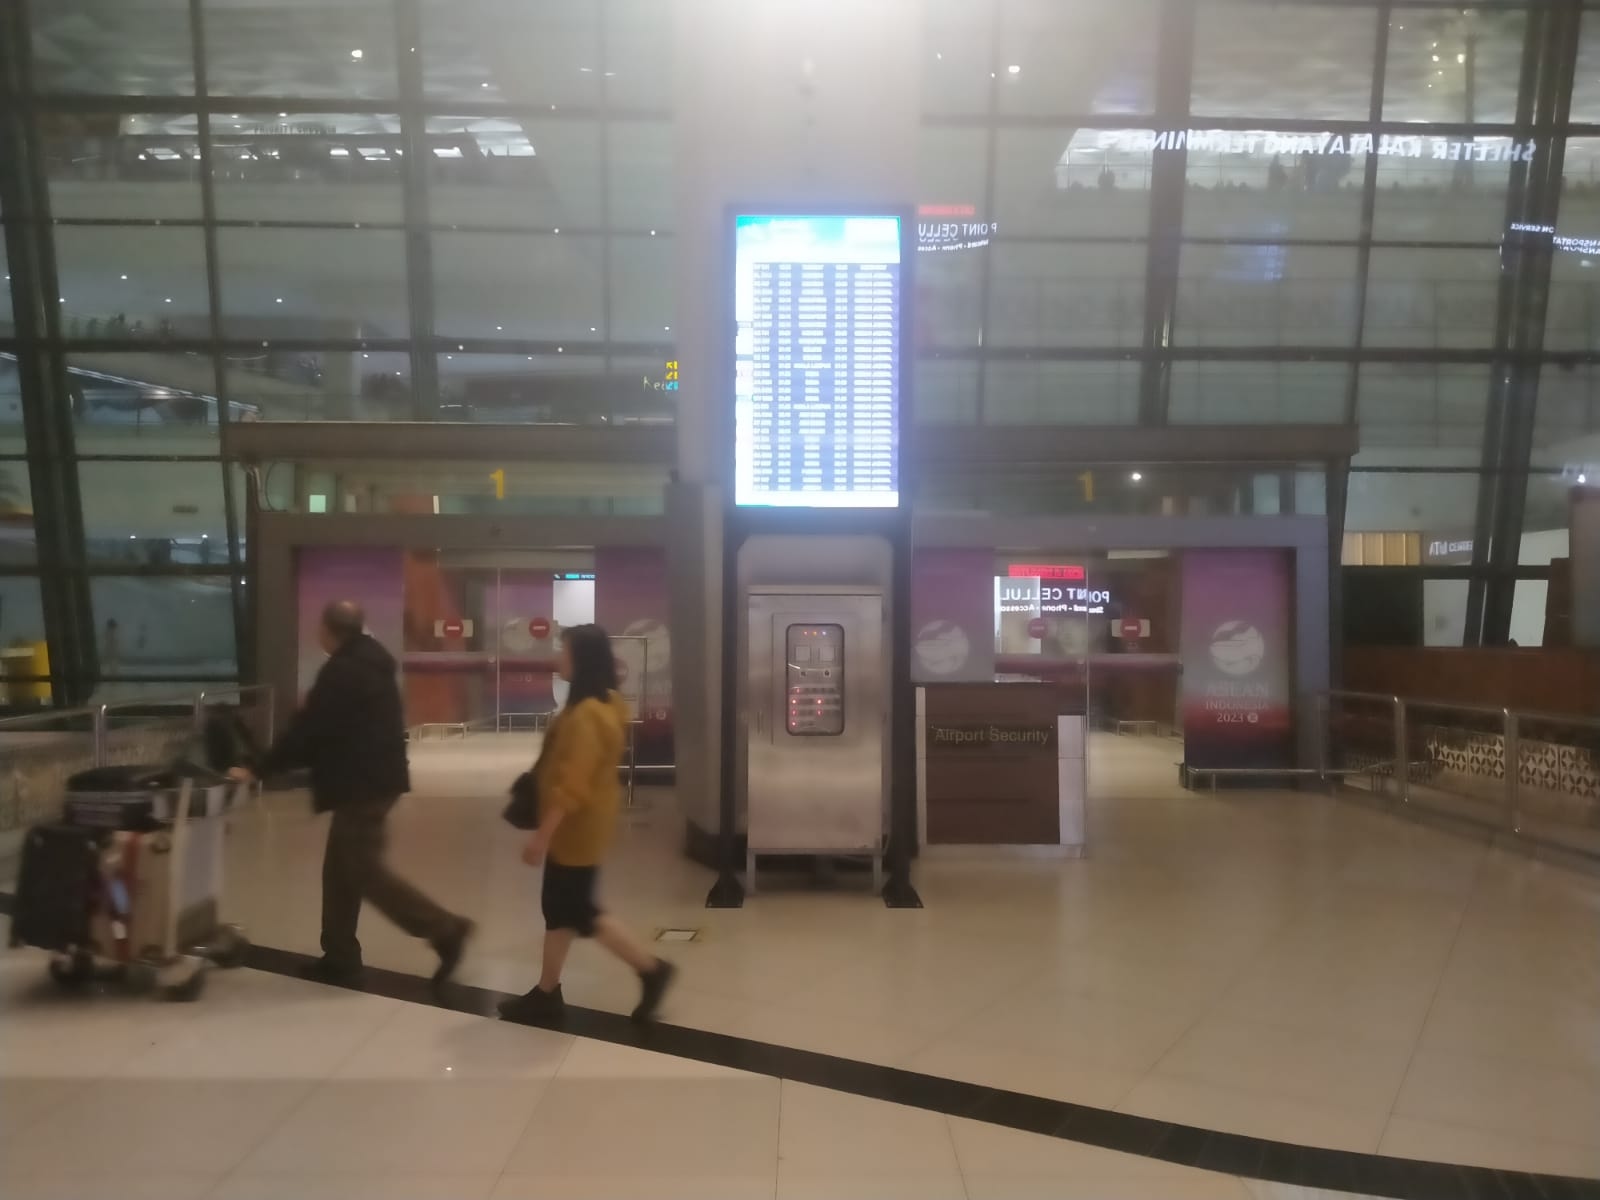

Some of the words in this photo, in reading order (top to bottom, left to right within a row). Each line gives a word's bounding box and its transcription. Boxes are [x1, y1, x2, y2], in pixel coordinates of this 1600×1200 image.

[1216, 712, 1245, 723] 2023
[936, 728, 984, 744] Airport
[990, 728, 1049, 744] Security
